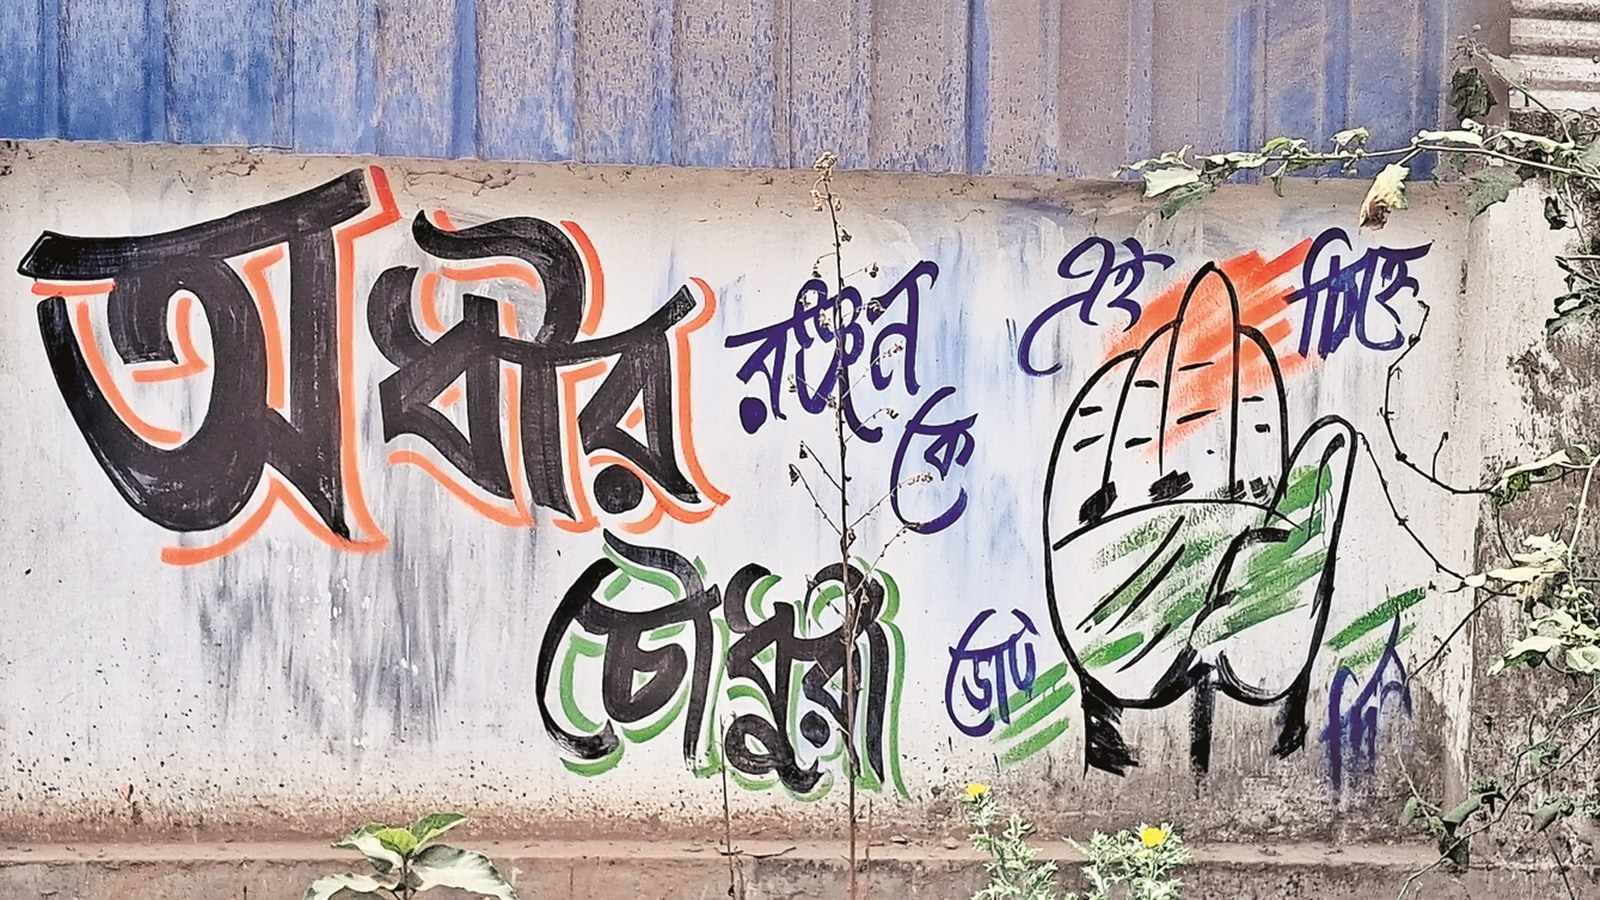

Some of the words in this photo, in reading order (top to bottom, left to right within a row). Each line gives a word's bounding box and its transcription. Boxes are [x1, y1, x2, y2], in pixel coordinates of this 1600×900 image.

[17, 165, 730, 564] অধীর
[1017, 236, 1176, 377] এই
[890, 386, 979, 534] কে
[536, 528, 912, 802] চৌধুরী
[944, 608, 1041, 738] ভোট
